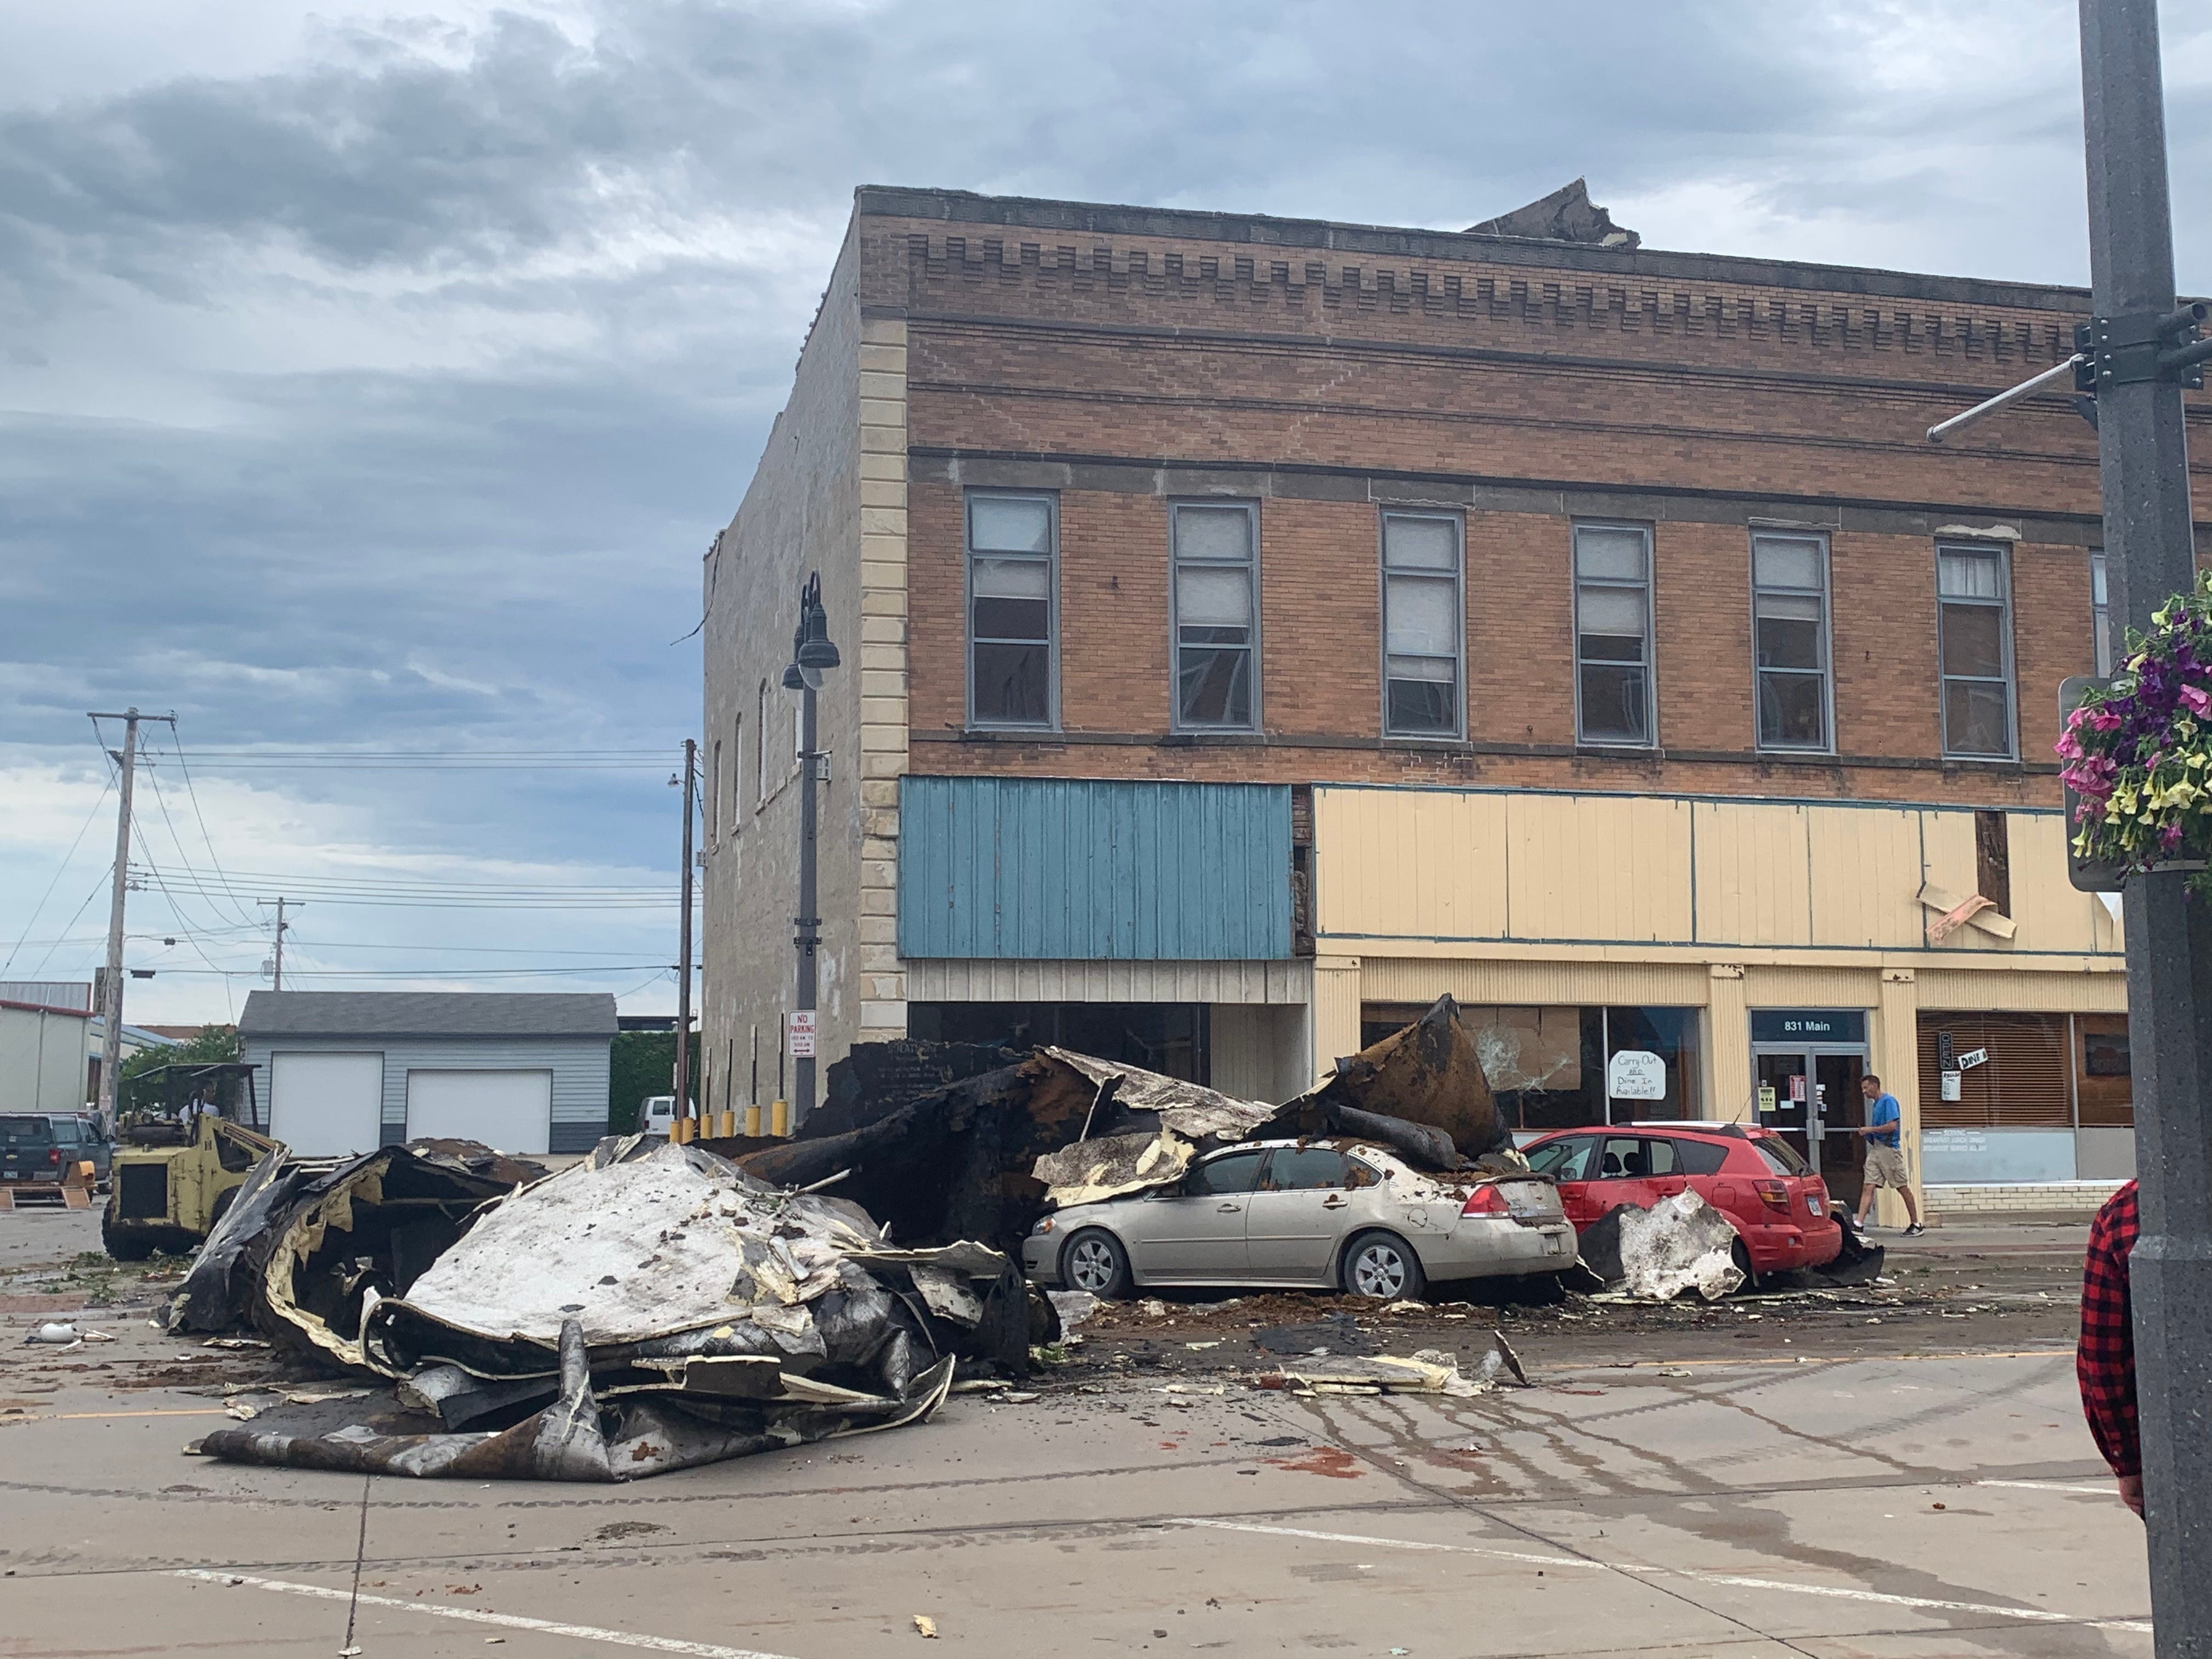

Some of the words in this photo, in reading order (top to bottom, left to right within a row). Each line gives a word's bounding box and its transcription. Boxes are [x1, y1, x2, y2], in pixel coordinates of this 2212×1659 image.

[797, 1014, 808, 1024] NO
[790, 1025, 814, 1034] PARKING
[1785, 1021, 1802, 1031] 831
[1805, 1021, 1830, 1031] Main
[1618, 1055, 1640, 1069] Carry
[1642, 1055, 1657, 1065] Out
